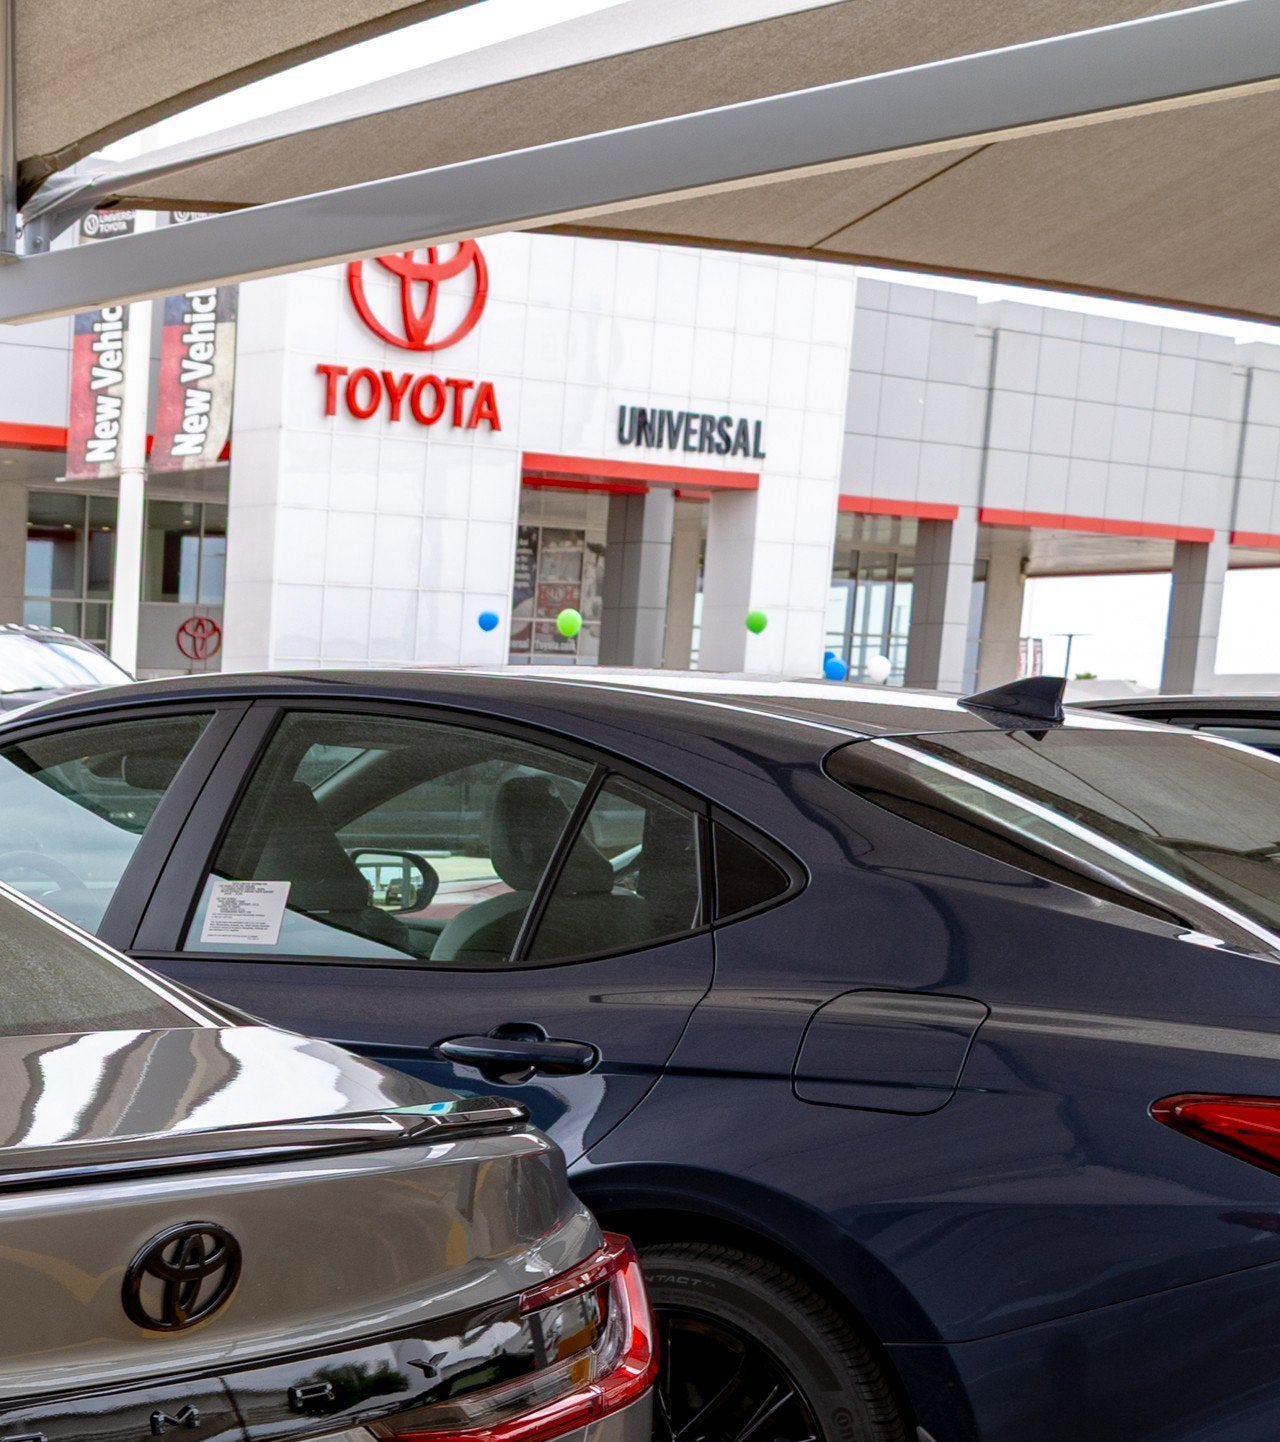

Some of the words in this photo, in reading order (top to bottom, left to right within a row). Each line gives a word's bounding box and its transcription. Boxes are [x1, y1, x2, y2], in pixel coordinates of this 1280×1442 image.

[90, 305, 124, 390] Vehic
[180, 287, 217, 383] Vehicl
[85, 395, 122, 462] New
[171, 388, 212, 456] New
[315, 363, 502, 432] TOYOTA
[618, 404, 767, 459] UNIVERSAL
